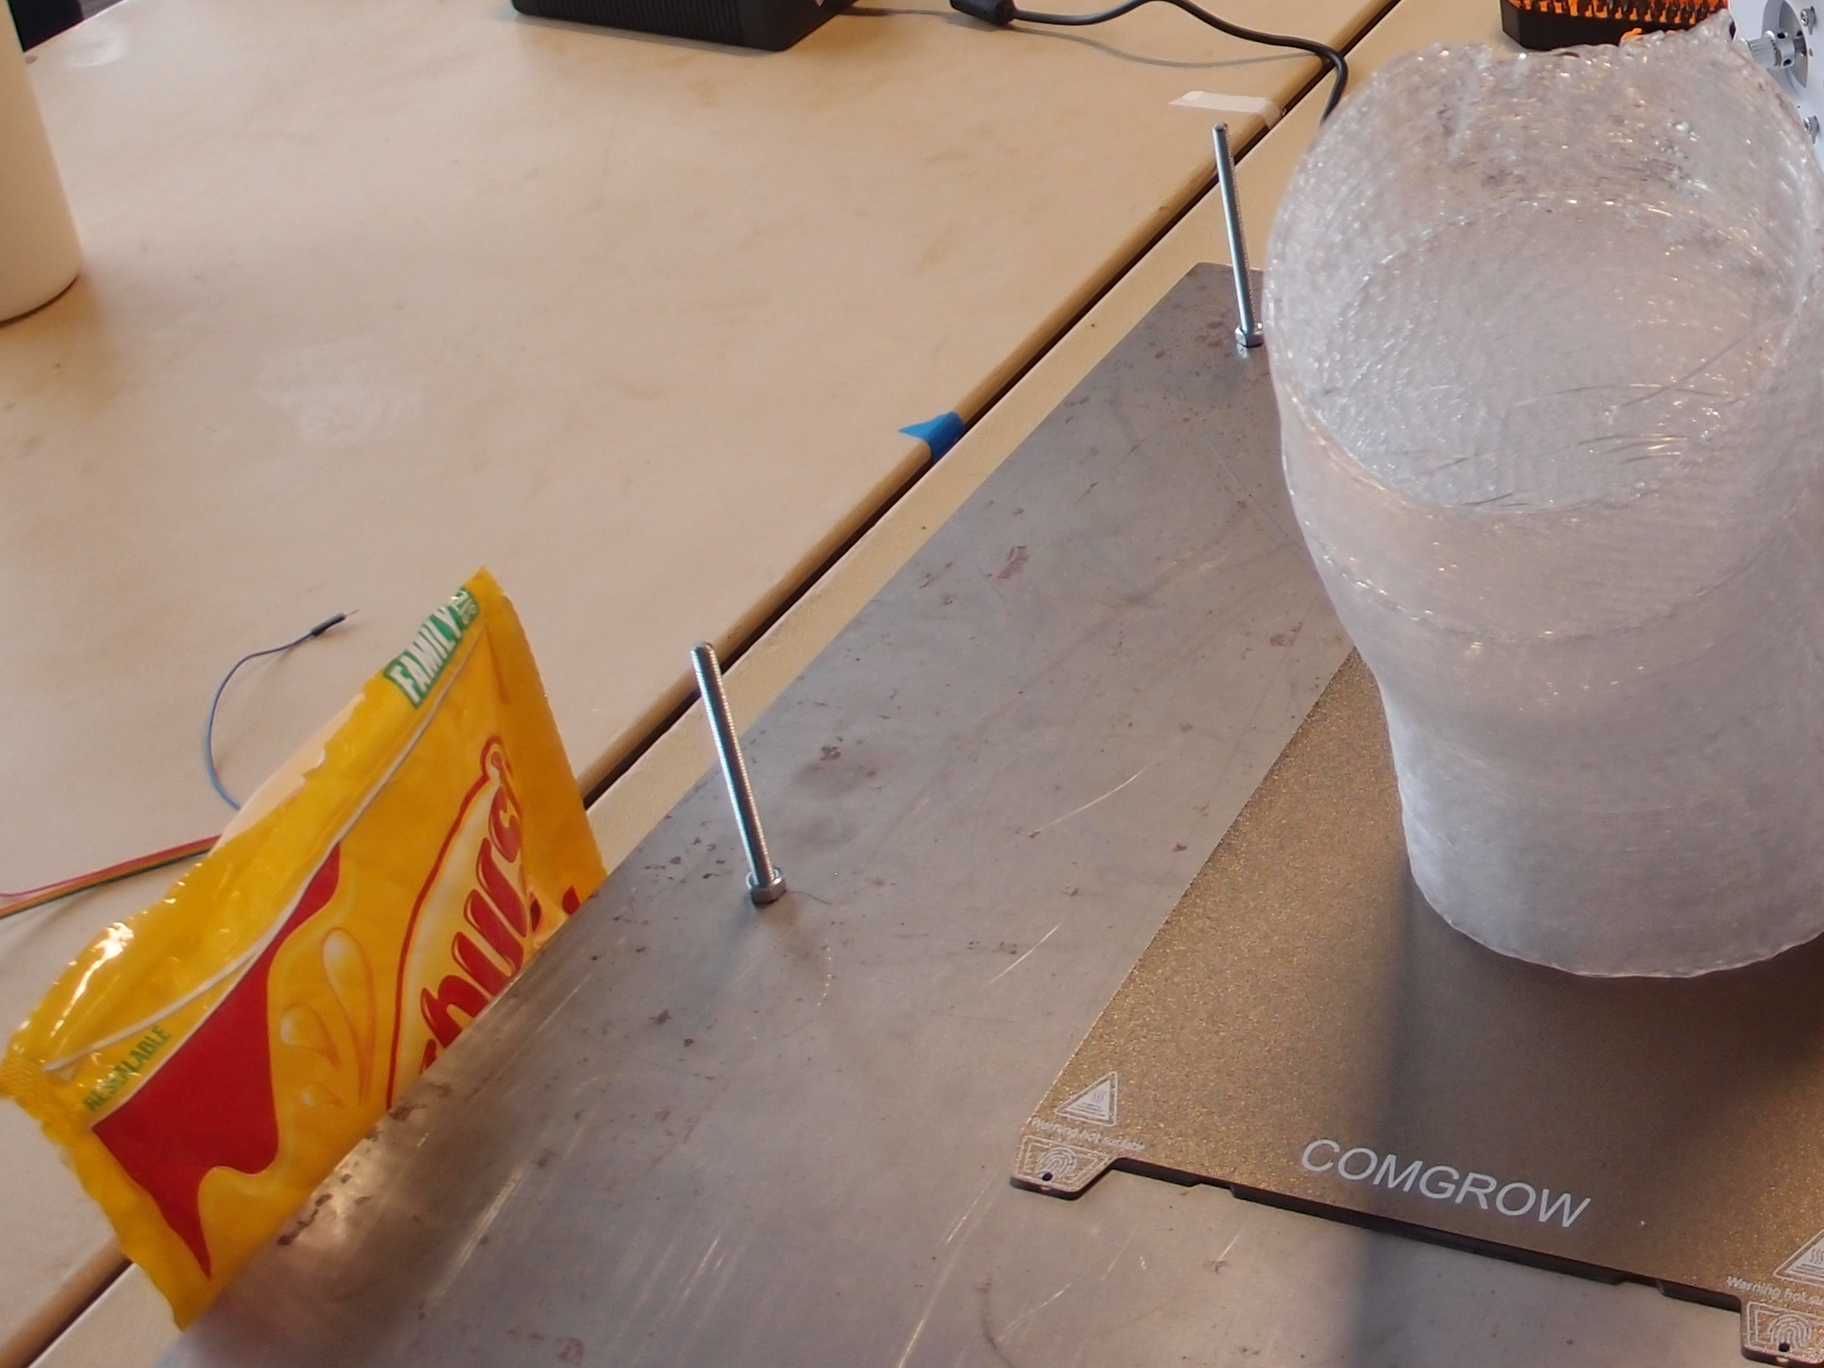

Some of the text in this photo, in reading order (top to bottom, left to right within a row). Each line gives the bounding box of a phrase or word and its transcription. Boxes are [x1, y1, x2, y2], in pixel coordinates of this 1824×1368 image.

[389, 607, 462, 704] FAMILY
[1301, 1138, 1592, 1228] COMGROW
[1726, 1275, 1781, 1300] Warning
[1784, 1288, 1807, 1303] hot
